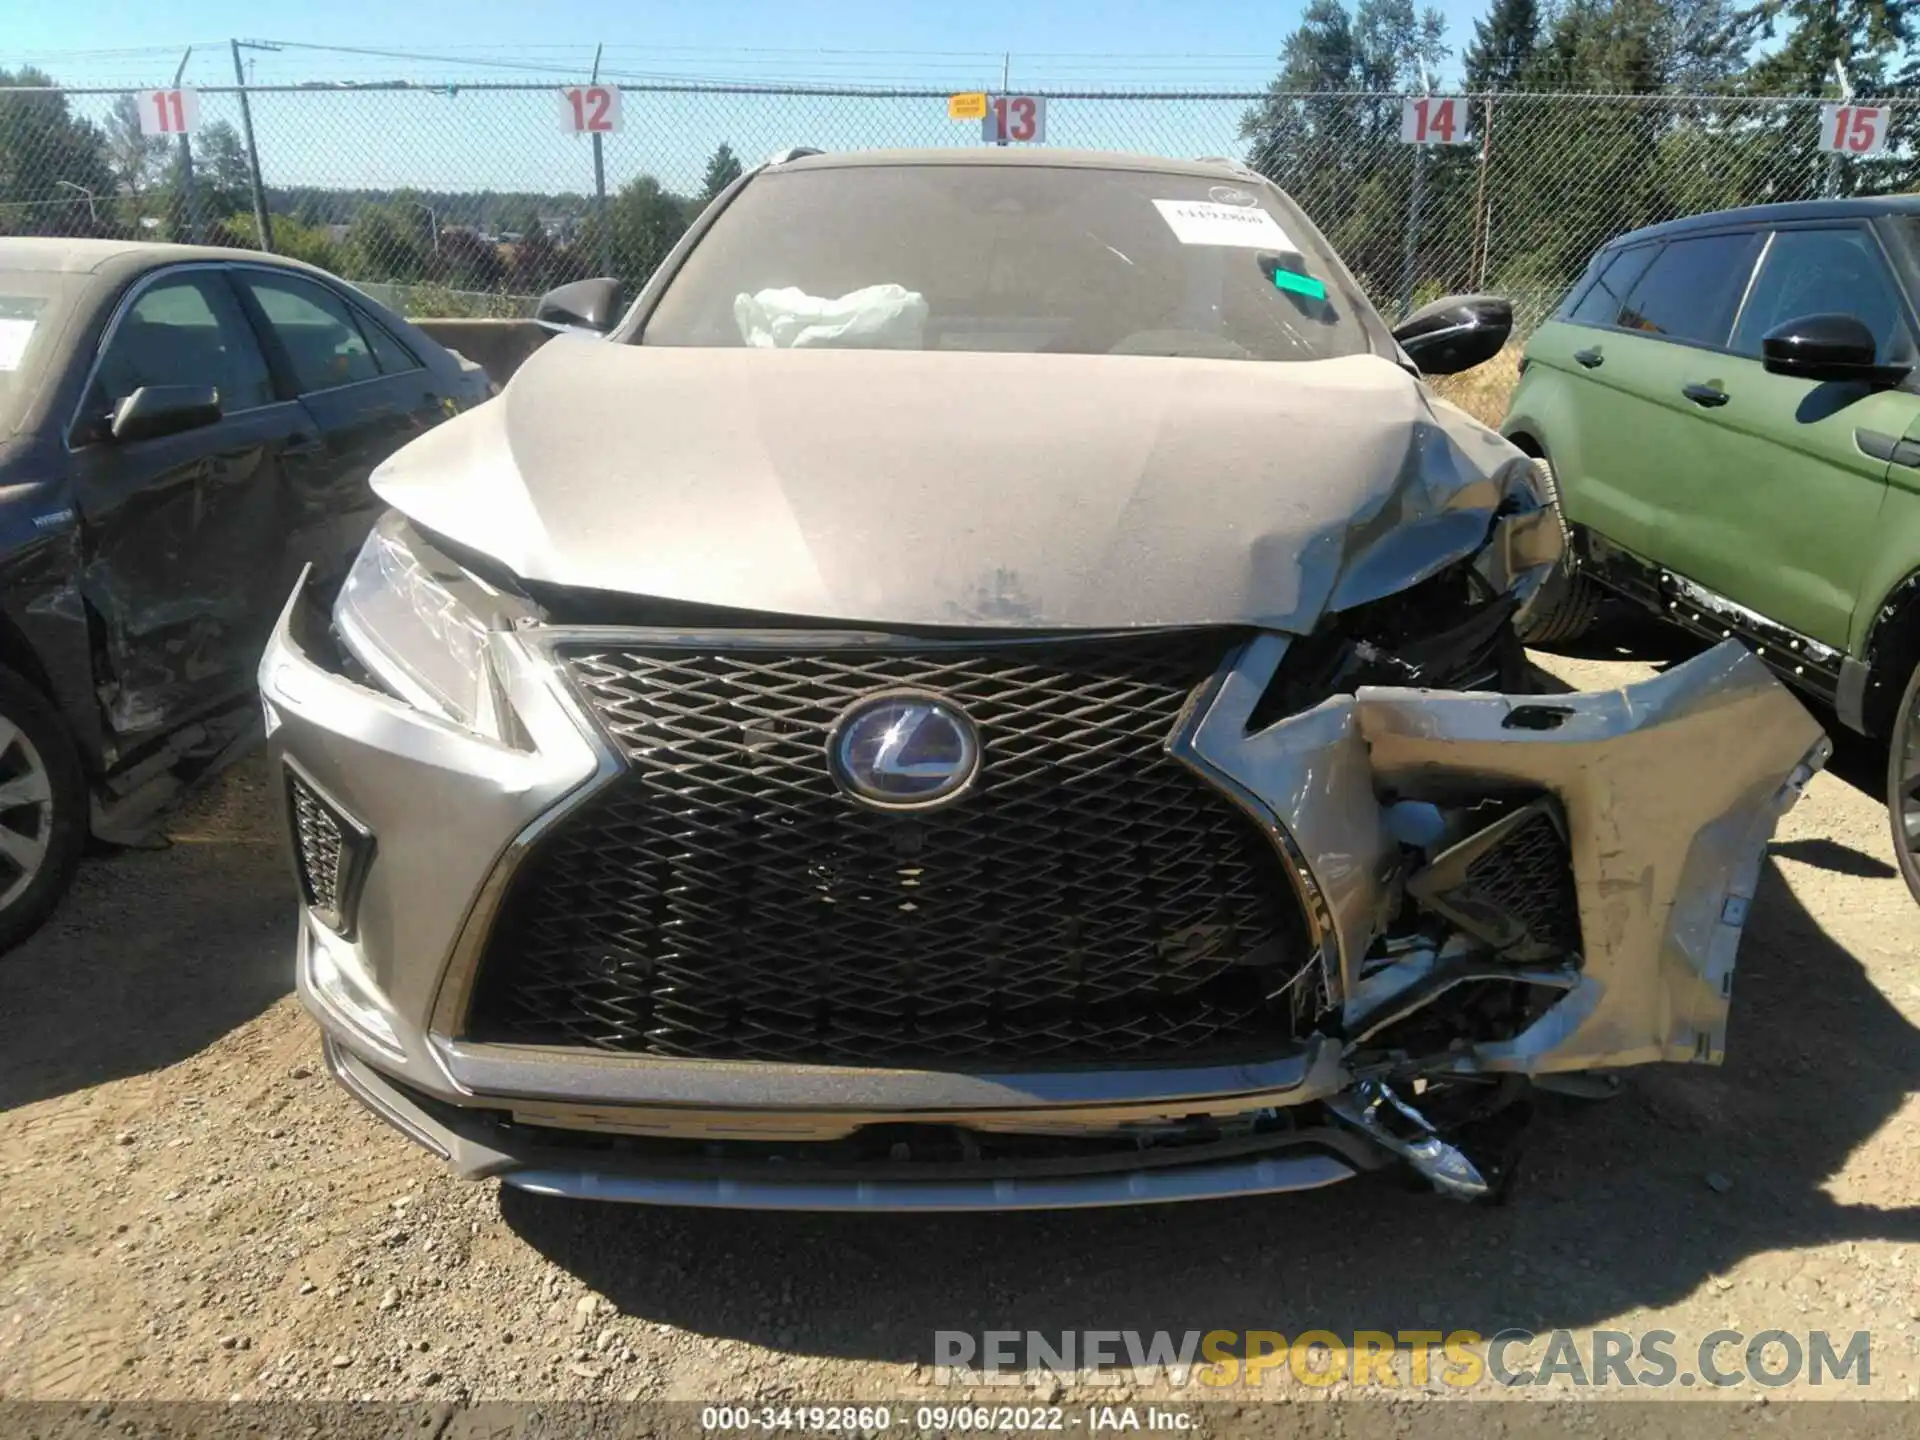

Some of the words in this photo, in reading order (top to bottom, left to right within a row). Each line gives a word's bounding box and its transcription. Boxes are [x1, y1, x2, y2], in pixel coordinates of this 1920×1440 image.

[152, 91, 185, 131] 11
[569, 88, 612, 130] 12
[994, 97, 1036, 141] 13
[1414, 99, 1456, 141] 14
[1833, 108, 1878, 151] 15
